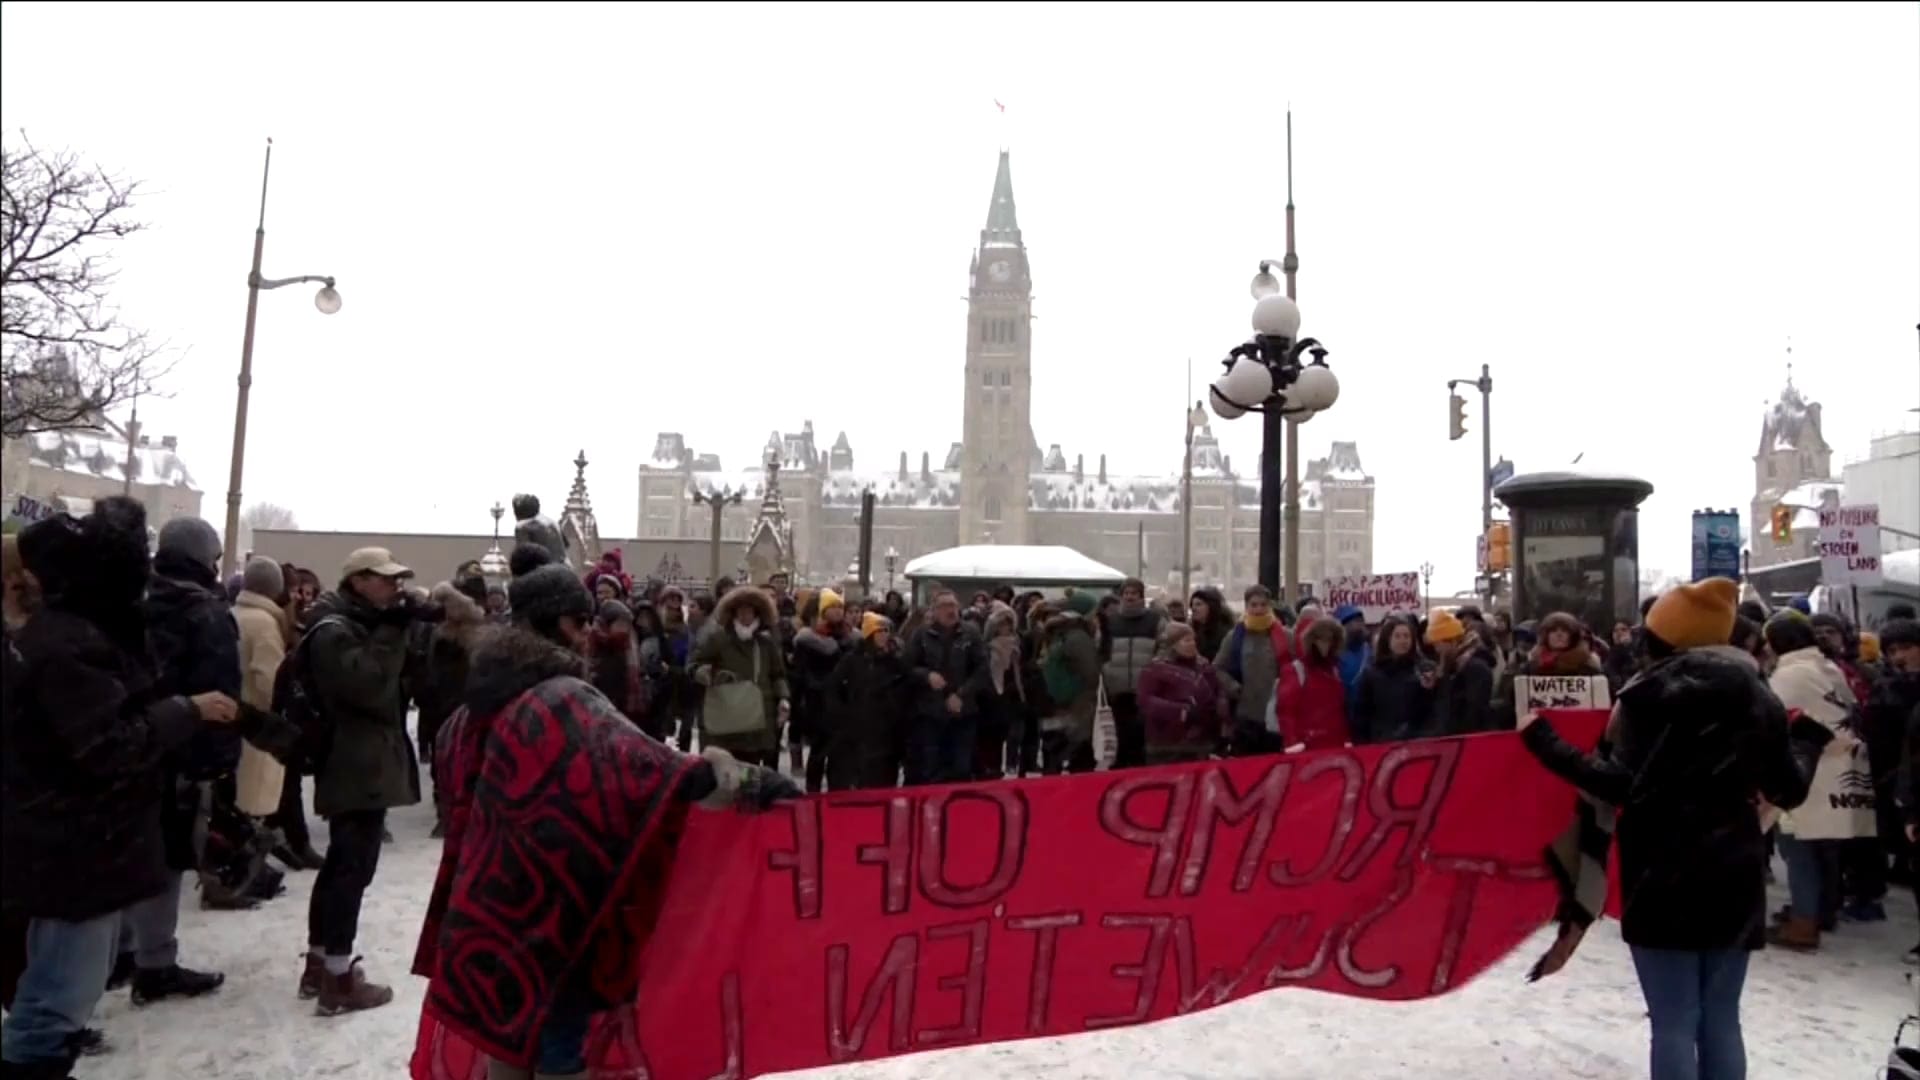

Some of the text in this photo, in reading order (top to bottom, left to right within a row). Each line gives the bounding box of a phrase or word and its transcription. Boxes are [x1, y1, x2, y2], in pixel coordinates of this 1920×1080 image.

[1820, 511, 1836, 527] NO
[1821, 541, 1858, 557] STOLEN
[1848, 556, 1878, 571] LAND
[1532, 678, 1586, 693] WATER
